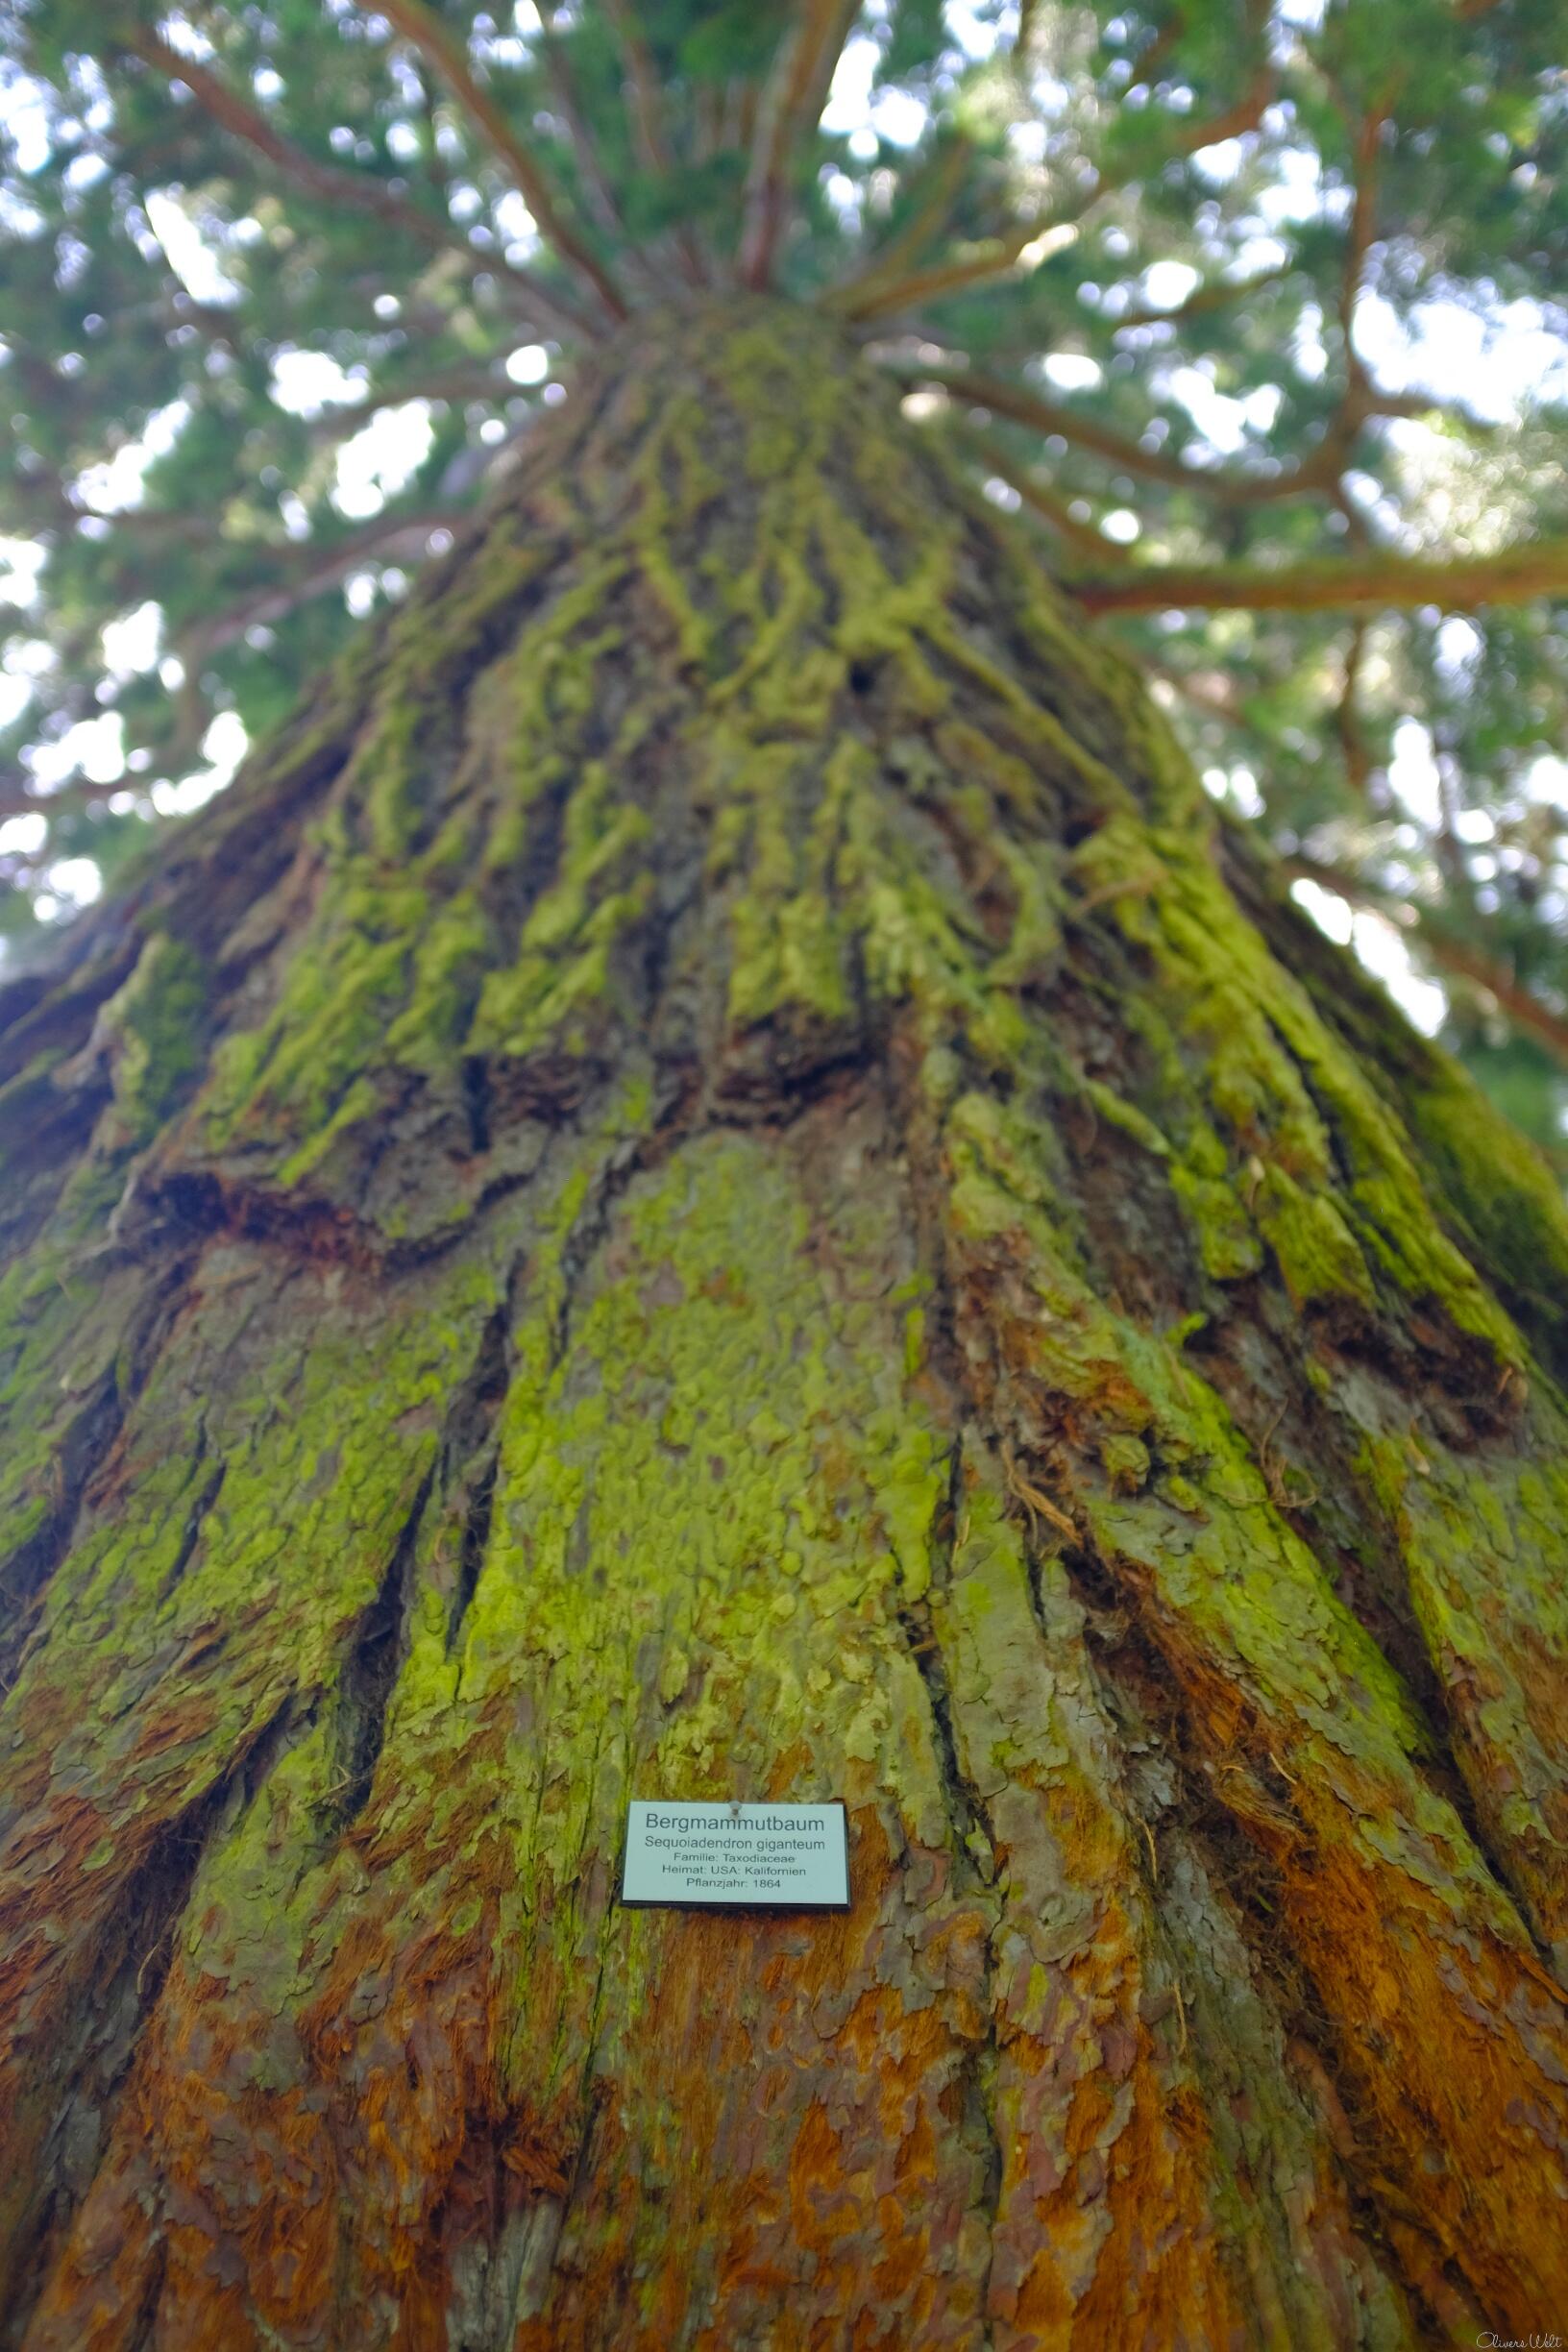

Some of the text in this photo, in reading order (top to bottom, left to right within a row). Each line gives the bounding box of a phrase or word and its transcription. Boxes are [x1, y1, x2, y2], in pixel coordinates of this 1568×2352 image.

[646, 1813, 825, 1832] Bergmammutbaum
[645, 1836, 825, 1852] Sequoiadendron giganteum
[673, 1851, 796, 1863] Familie: Taxodiaceae
[661, 1864, 707, 1874] Heimat:
[745, 1866, 806, 1876] Kalifornien
[686, 1877, 781, 1889] Pflanzjahr: 1864
